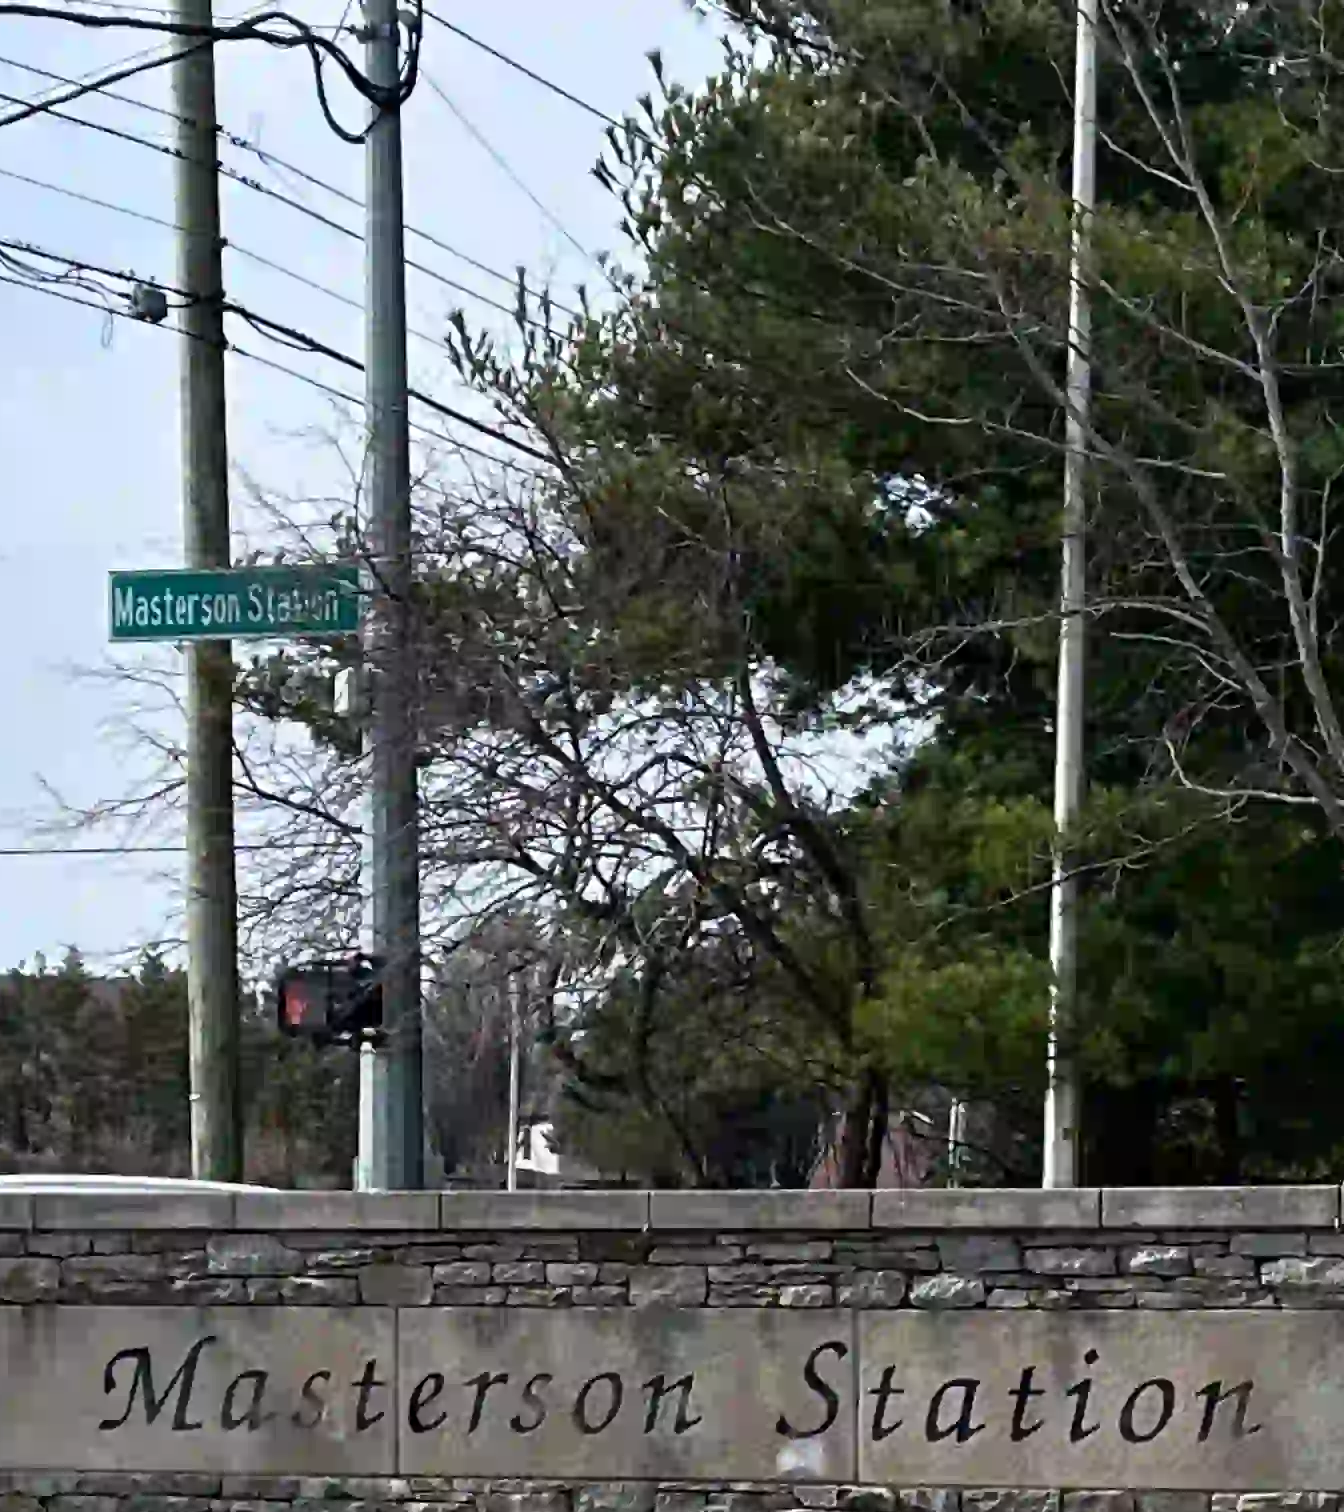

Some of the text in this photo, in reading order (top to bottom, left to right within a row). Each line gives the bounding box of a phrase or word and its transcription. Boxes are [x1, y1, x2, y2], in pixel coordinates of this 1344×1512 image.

[114, 585, 240, 627] Masterson
[98, 1334, 1262, 1444] Masterson Station
